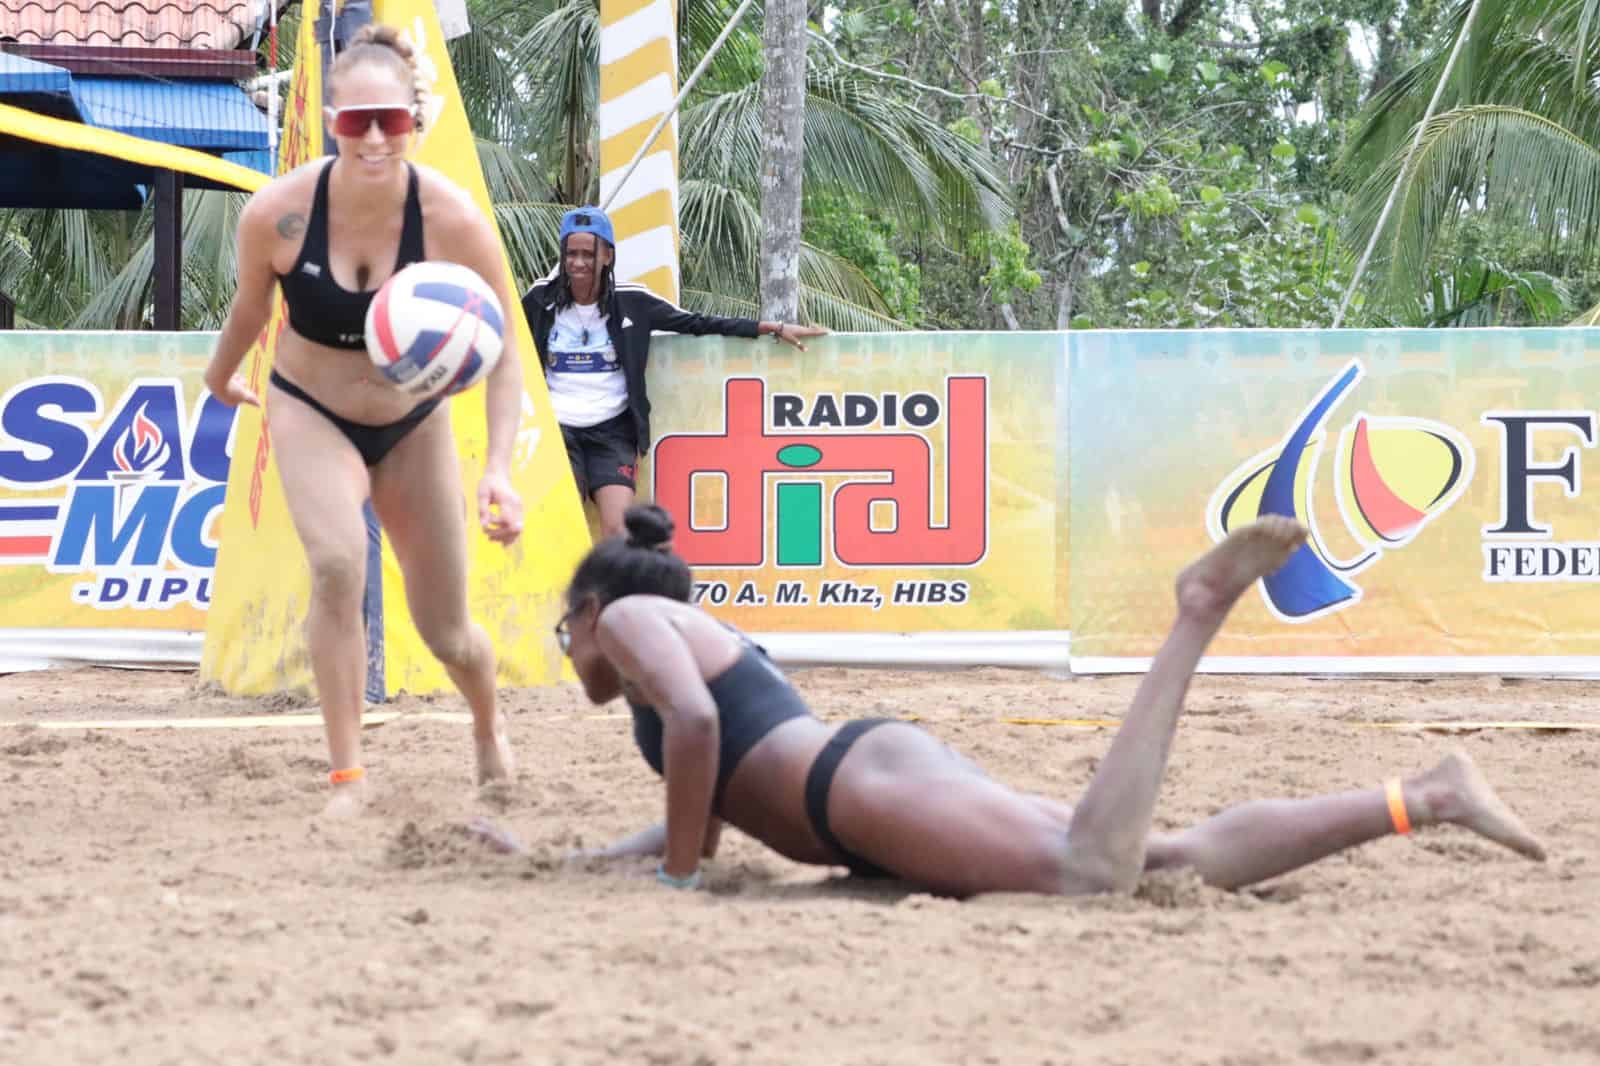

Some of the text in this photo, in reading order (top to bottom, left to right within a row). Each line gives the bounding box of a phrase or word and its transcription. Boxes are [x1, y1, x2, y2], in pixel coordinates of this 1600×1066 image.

[773, 394, 940, 427] RADIO
[1486, 416, 1593, 533] F
[1490, 547, 1600, 576] FEDE
[736, 583, 765, 603] A.
[775, 583, 808, 603] M.
[820, 583, 882, 608] Khz,
[893, 582, 967, 603] HIBS
